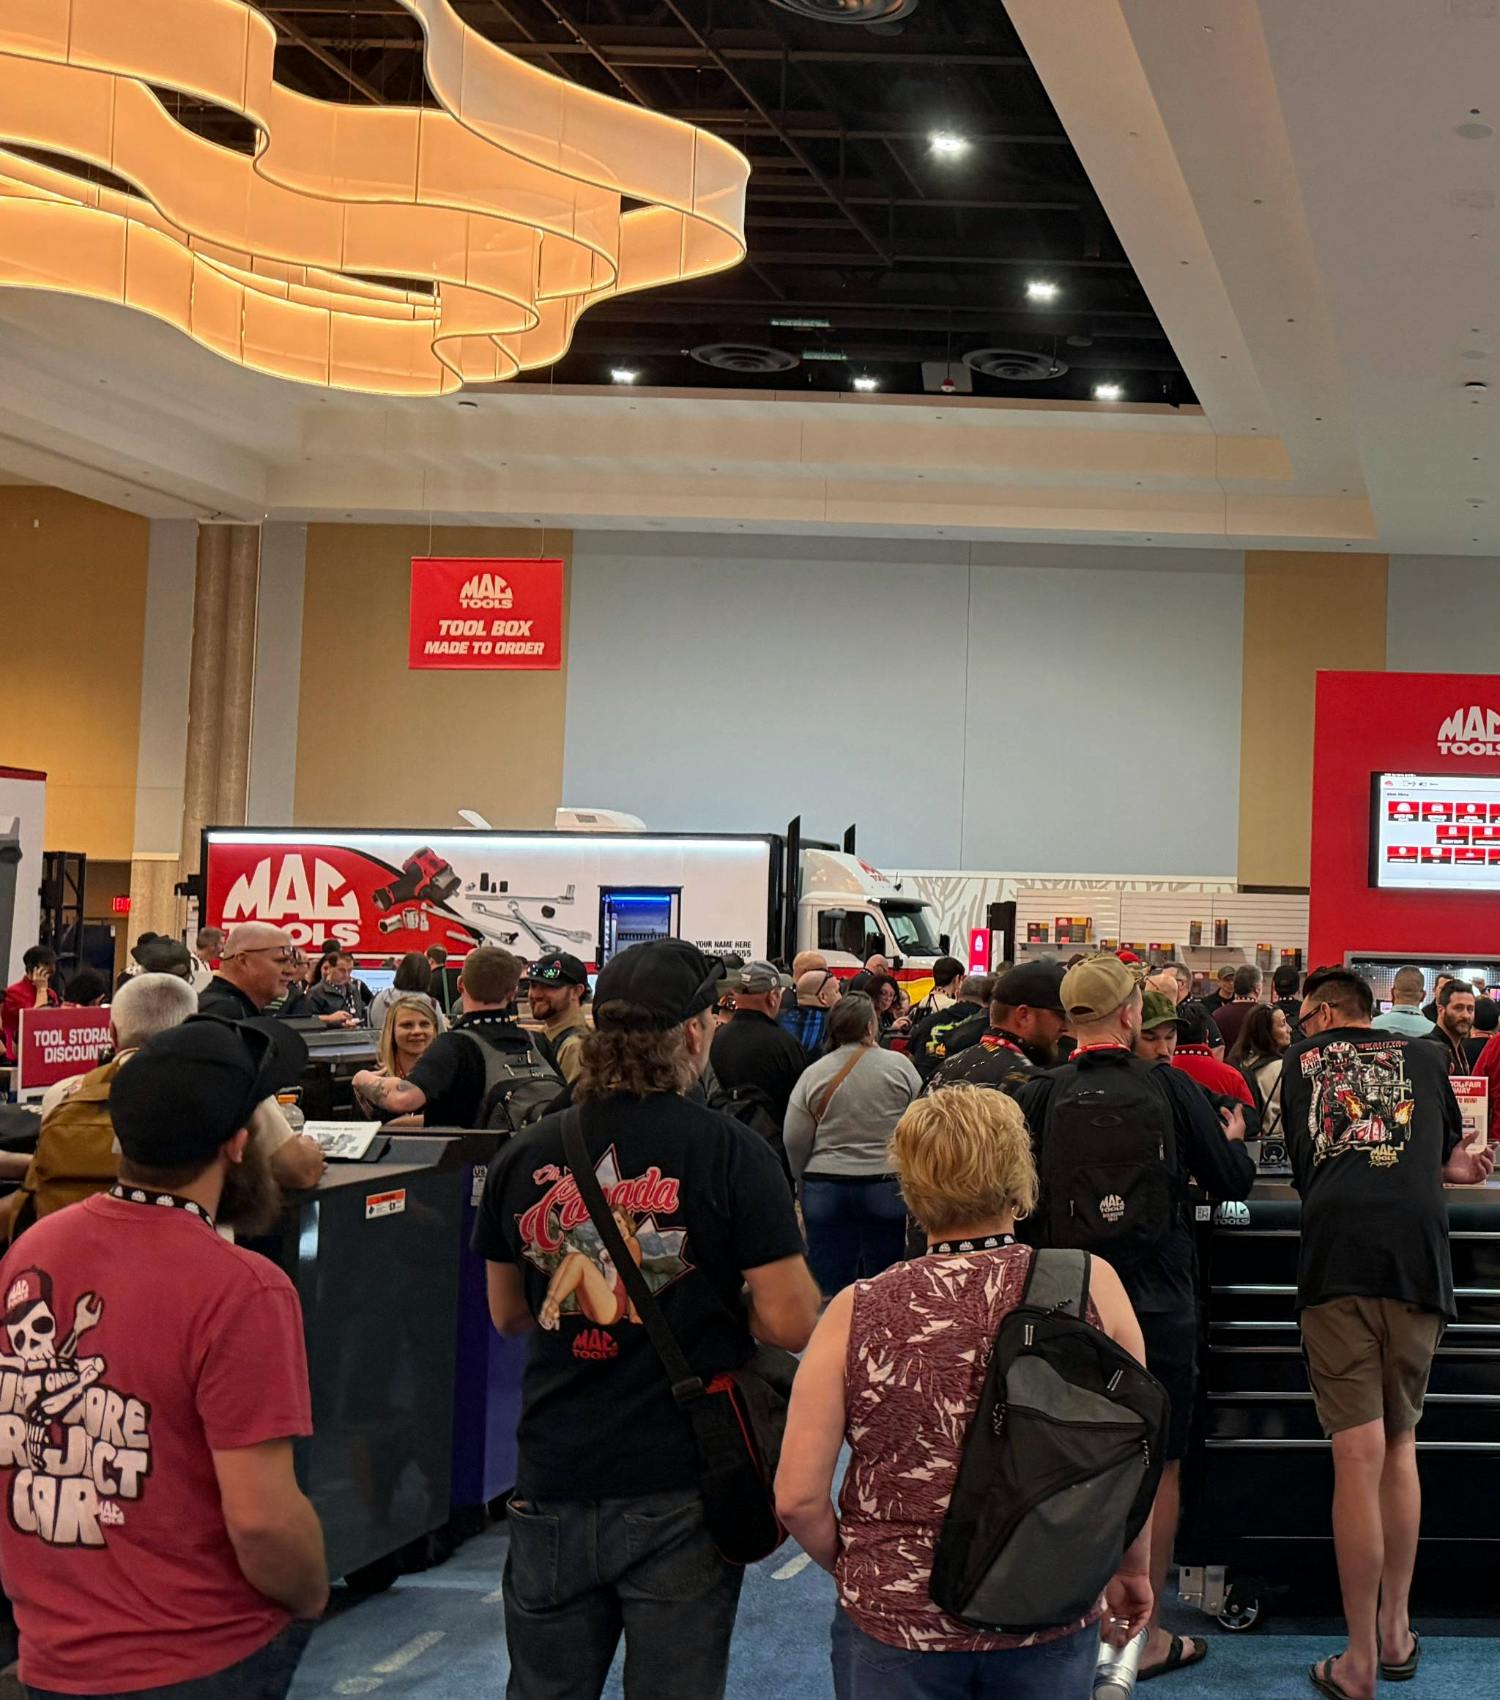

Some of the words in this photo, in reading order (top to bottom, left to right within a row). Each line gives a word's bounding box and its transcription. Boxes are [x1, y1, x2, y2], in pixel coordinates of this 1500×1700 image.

[459, 573, 513, 598] MAC
[460, 599, 513, 608] TOOLS
[439, 620, 486, 636] TOOL
[491, 620, 533, 636] BOX
[424, 641, 469, 655] MADE
[472, 641, 492, 655] TO
[494, 642, 544, 655] ORDER
[222, 853, 361, 920] MAC
[696, 940, 712, 948] YOUR
[714, 940, 732, 948] NAME
[735, 941, 751, 949] HERE
[34, 1030, 65, 1046] TOOL
[1100, 1194, 1125, 1207] MAC
[1214, 1201, 1250, 1219] MAC
[572, 1329, 618, 1351] MAC
[13, 1469, 105, 1544] CAR
